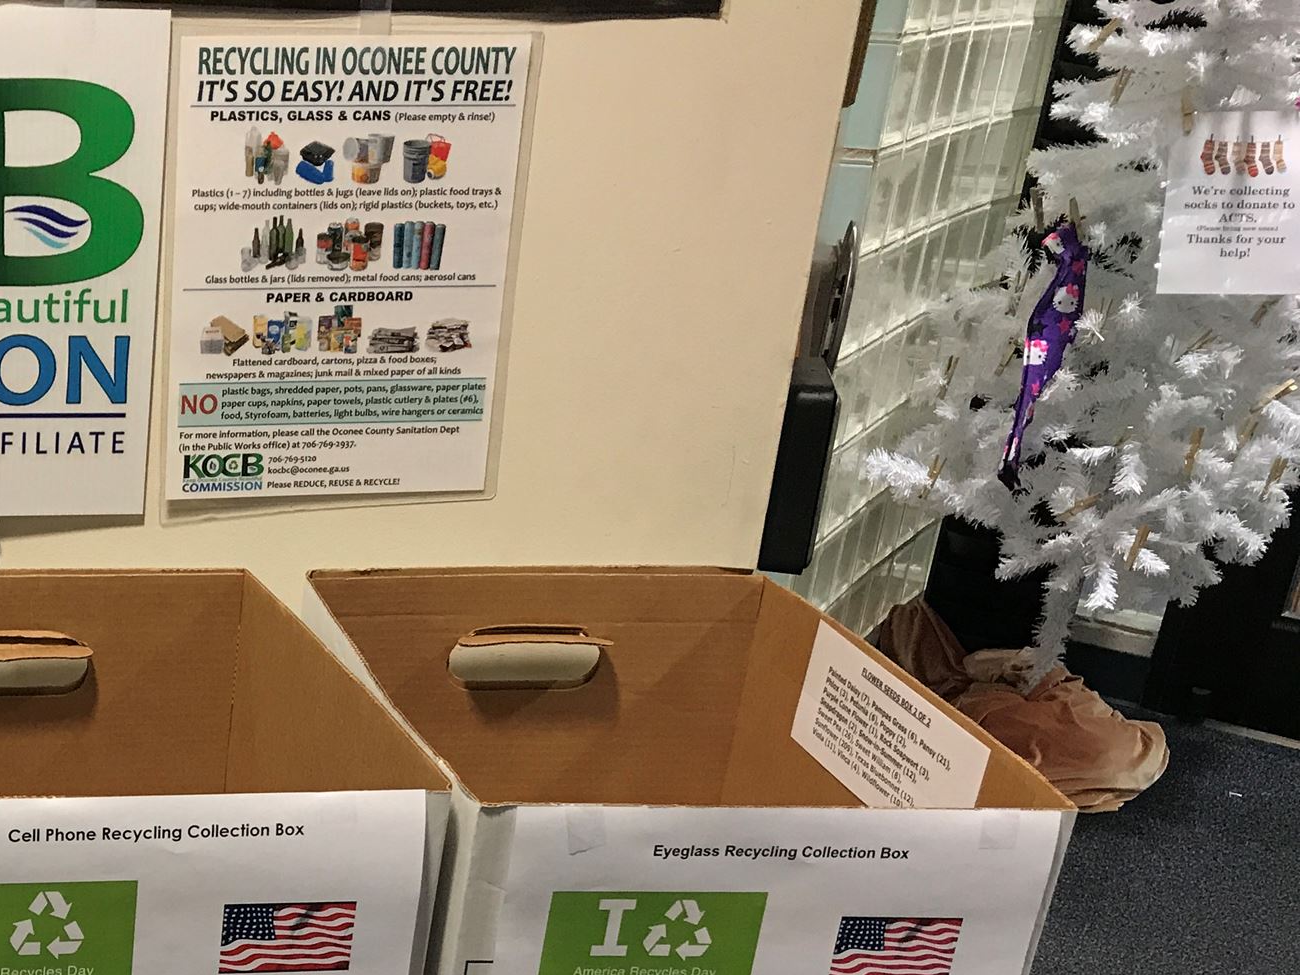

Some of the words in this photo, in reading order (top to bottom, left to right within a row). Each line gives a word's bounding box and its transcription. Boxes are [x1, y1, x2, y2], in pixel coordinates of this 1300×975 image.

[198, 46, 309, 75] RECYCLING
[315, 47, 336, 74] IN
[341, 46, 426, 75] OCONEE
[431, 46, 516, 75] COUNTY
[197, 78, 238, 102] IT'S
[243, 80, 274, 102] SO
[280, 79, 344, 102] EASY!
[347, 80, 398, 101] AND
[404, 78, 445, 101] IT'S
[450, 79, 512, 101] FREE!
[210, 110, 282, 122] PLASTICS,
[287, 110, 332, 121] GLASS
[337, 110, 347, 120] &
[352, 110, 390, 120] CANS
[394, 112, 426, 122] (Please
[428, 113, 456, 122] empty
[458, 112, 464, 120] &
[467, 111, 494, 122] rinse!)
[1192, 186, 1225, 195] We're
[1229, 186, 1289, 196] collecting
[1184, 200, 1217, 208] socks
[1236, 200, 1278, 208] donate
[1187, 234, 1231, 243] Thanks
[1236, 234, 1251, 243] for
[1219, 248, 1251, 258] help!
[266, 292, 310, 303] PAPER
[315, 292, 324, 302] &
[329, 291, 412, 302] CARDBOARD
[181, 394, 218, 415] NO
[268, 455, 316, 463] 706-769-5120
[183, 454, 264, 479] KOCB
[182, 481, 262, 492] COMMISSION
[293, 479, 326, 487] REDUCE,
[8, 828, 39, 842] Cell
[45, 828, 96, 841] Phone
[102, 825, 181, 842] Recycling
[187, 823, 269, 838] Collection
[275, 822, 304, 835] Box
[653, 844, 719, 859] Eyeglass
[724, 845, 797, 860] Recycling
[801, 845, 875, 858] Collection
[880, 847, 908, 858] Box
[590, 899, 637, 957] I
[573, 966, 625, 975] America
